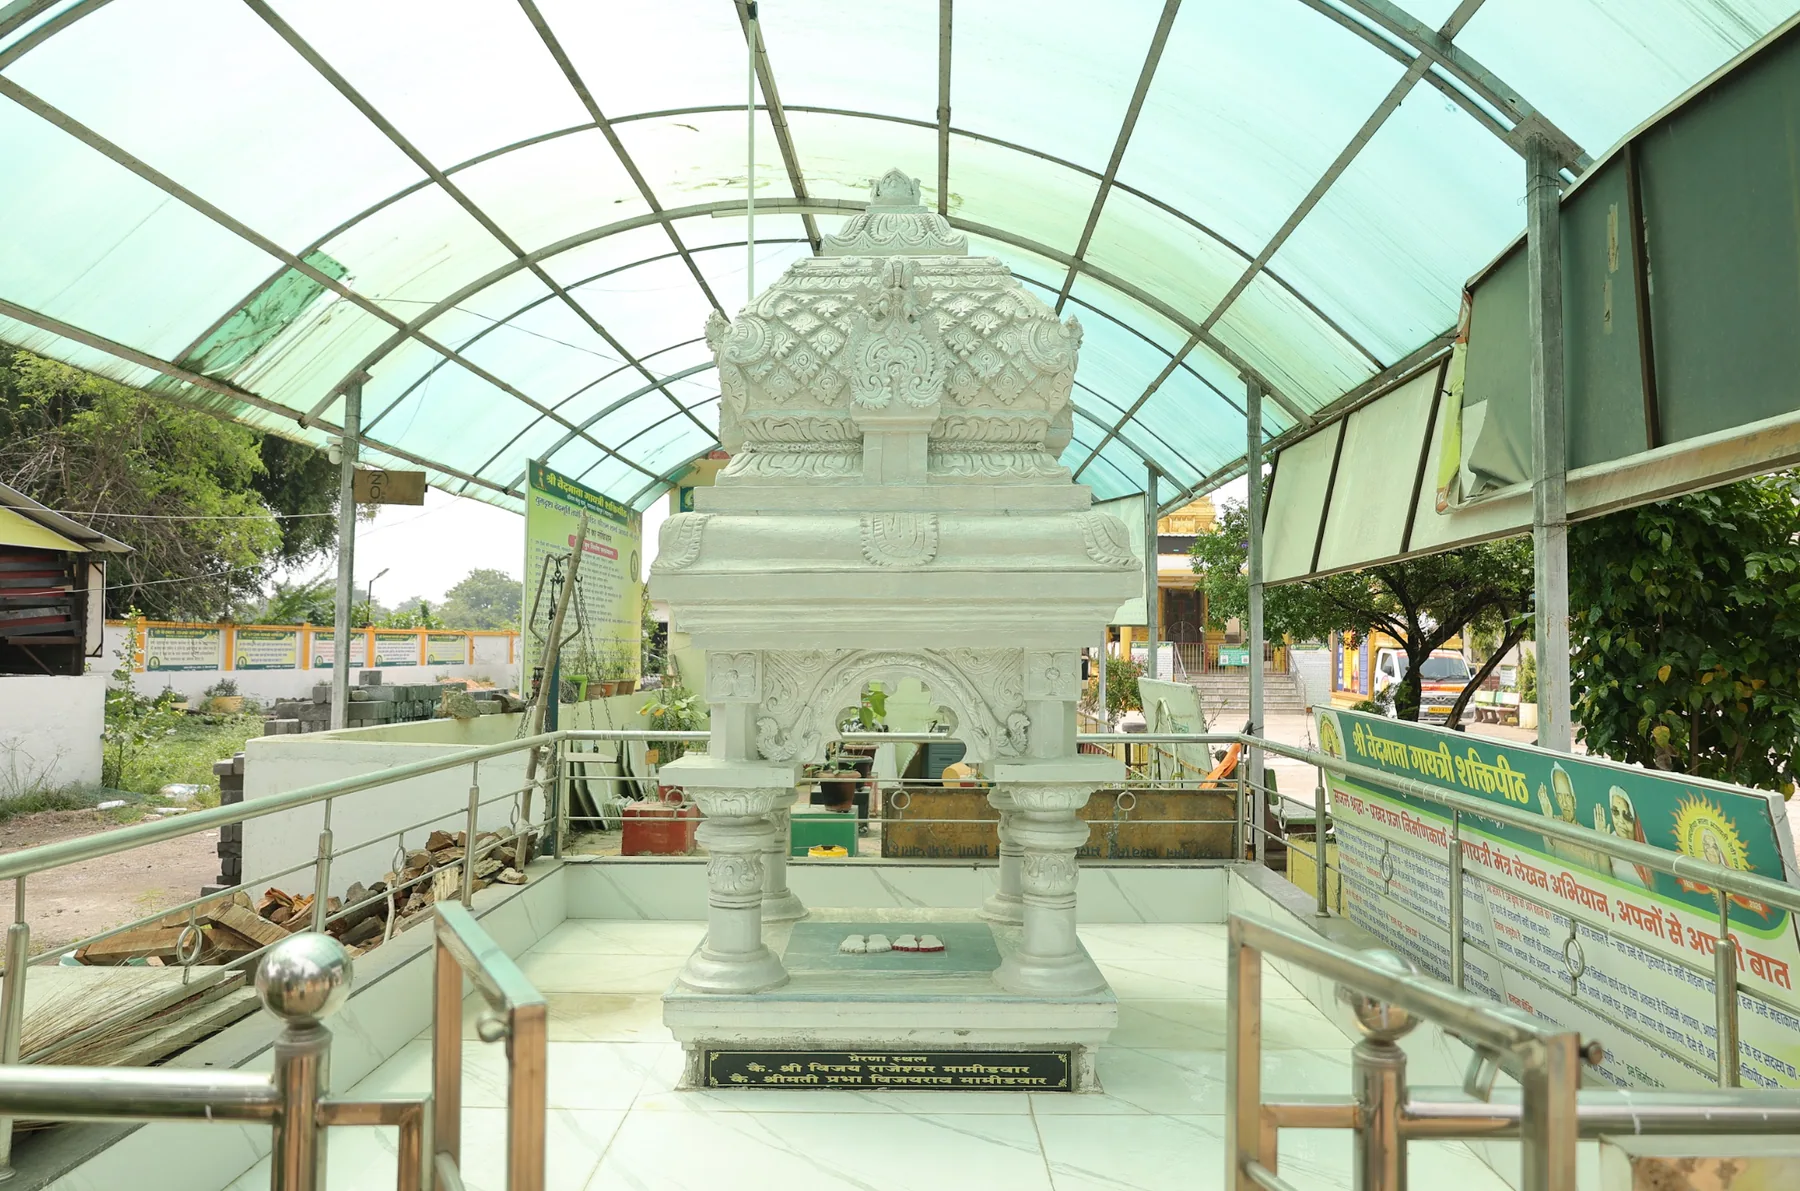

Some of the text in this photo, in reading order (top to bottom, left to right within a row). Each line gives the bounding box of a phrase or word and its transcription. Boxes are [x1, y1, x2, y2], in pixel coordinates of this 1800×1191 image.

[546, 472, 556, 487] श्री
[1352, 722, 1367, 758] श्री
[1366, 723, 1410, 771] वेदमाता
[1408, 741, 1456, 784] गायत्री
[1455, 747, 1530, 804] शक्तिपीठ
[1369, 803, 1386, 826] प्रखर
[1386, 810, 1401, 830] प्रज्ञा
[1401, 811, 1448, 849] निर्माणकार्य
[1462, 842, 1491, 871] गायत्री
[1492, 853, 1513, 878] मंत्र
[1513, 855, 1549, 892] लेखन
[1550, 872, 1614, 923] अभियान,
[1617, 900, 1665, 939] अपनों
[1665, 912, 1685, 948] से
[1745, 949, 1792, 991] बात
[849, 1053, 885, 1062] प्रेरणा
[780, 1062, 802, 1073] श्री
[808, 1062, 862, 1073] विजय
[867, 1063, 936, 1074] राजेश्वर
[942, 1063, 1030, 1074] मामीडवार
[763, 1073, 820, 1084] श्रीमती
[825, 1076, 862, 1084] प्रभा
[869, 1073, 953, 1085] विजयराव
[959, 1074, 1047, 1085] मामीडवार
